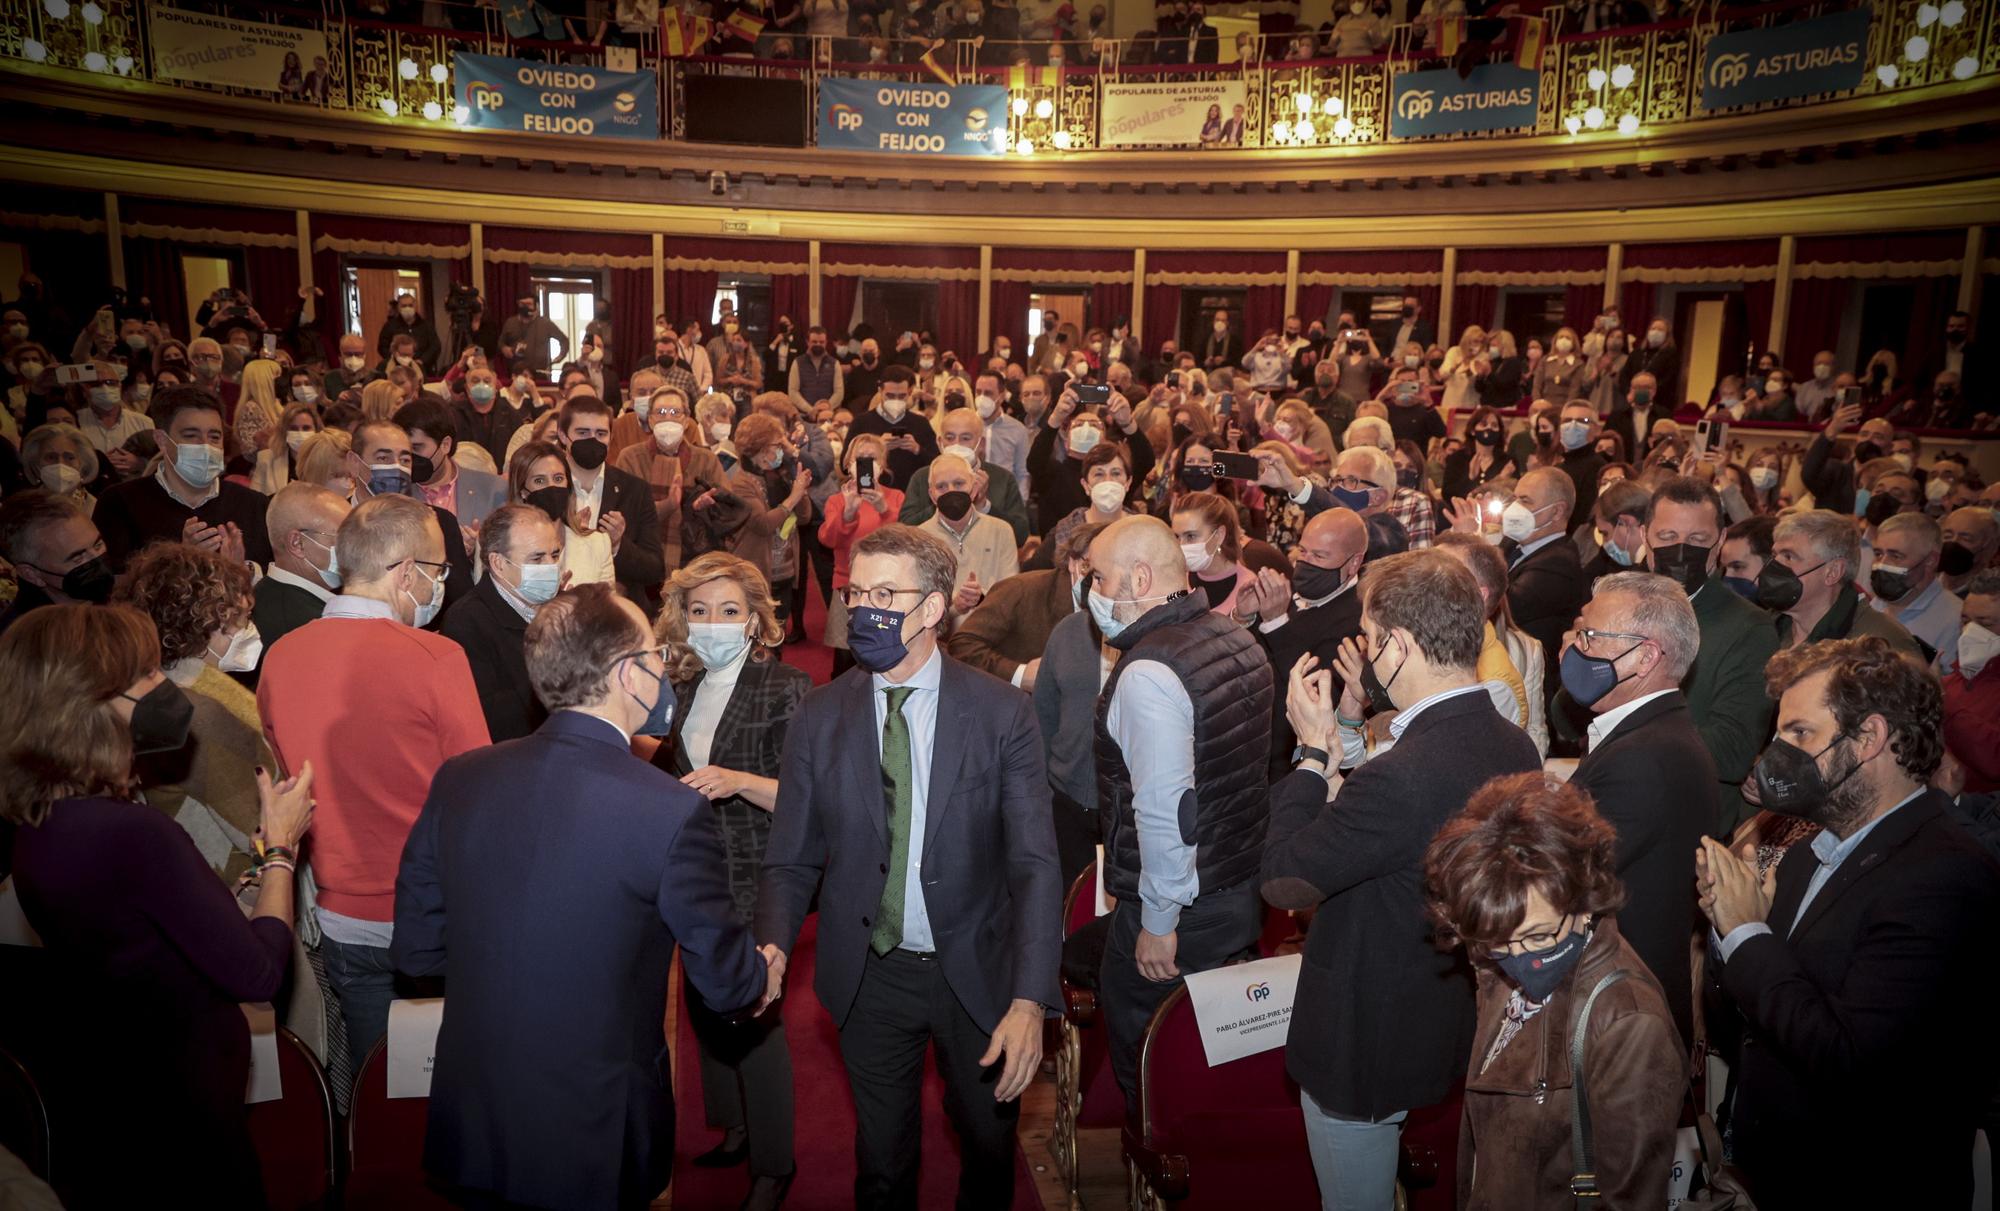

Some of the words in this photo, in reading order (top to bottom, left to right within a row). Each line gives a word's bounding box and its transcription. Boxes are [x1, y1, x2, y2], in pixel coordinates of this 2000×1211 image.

[156, 11, 227, 30] POPULARES
[230, 23, 245, 33] DE
[247, 26, 303, 41] ASTURIAS
[161, 43, 256, 72] populares
[1754, 42, 1859, 77] ASTURIAS
[517, 67, 596, 90] OVIEDO
[540, 92, 576, 109] CON
[877, 88, 950, 108] OVIEDO
[1109, 88, 1164, 96] POPULARES
[1166, 87, 1178, 95] DE
[1180, 86, 1226, 94] ASTURIAS
[1439, 88, 1532, 112] ASTURIAS
[523, 113, 594, 135] FEIJOO
[613, 114, 639, 125] NNGG
[896, 112, 930, 127] CON
[1109, 102, 1185, 138] populares
[879, 133, 945, 152] FEIJOO
[1216, 1022, 1238, 1033] PABLO
[1240, 1021, 1278, 1035] VICEPRESIDENTE
